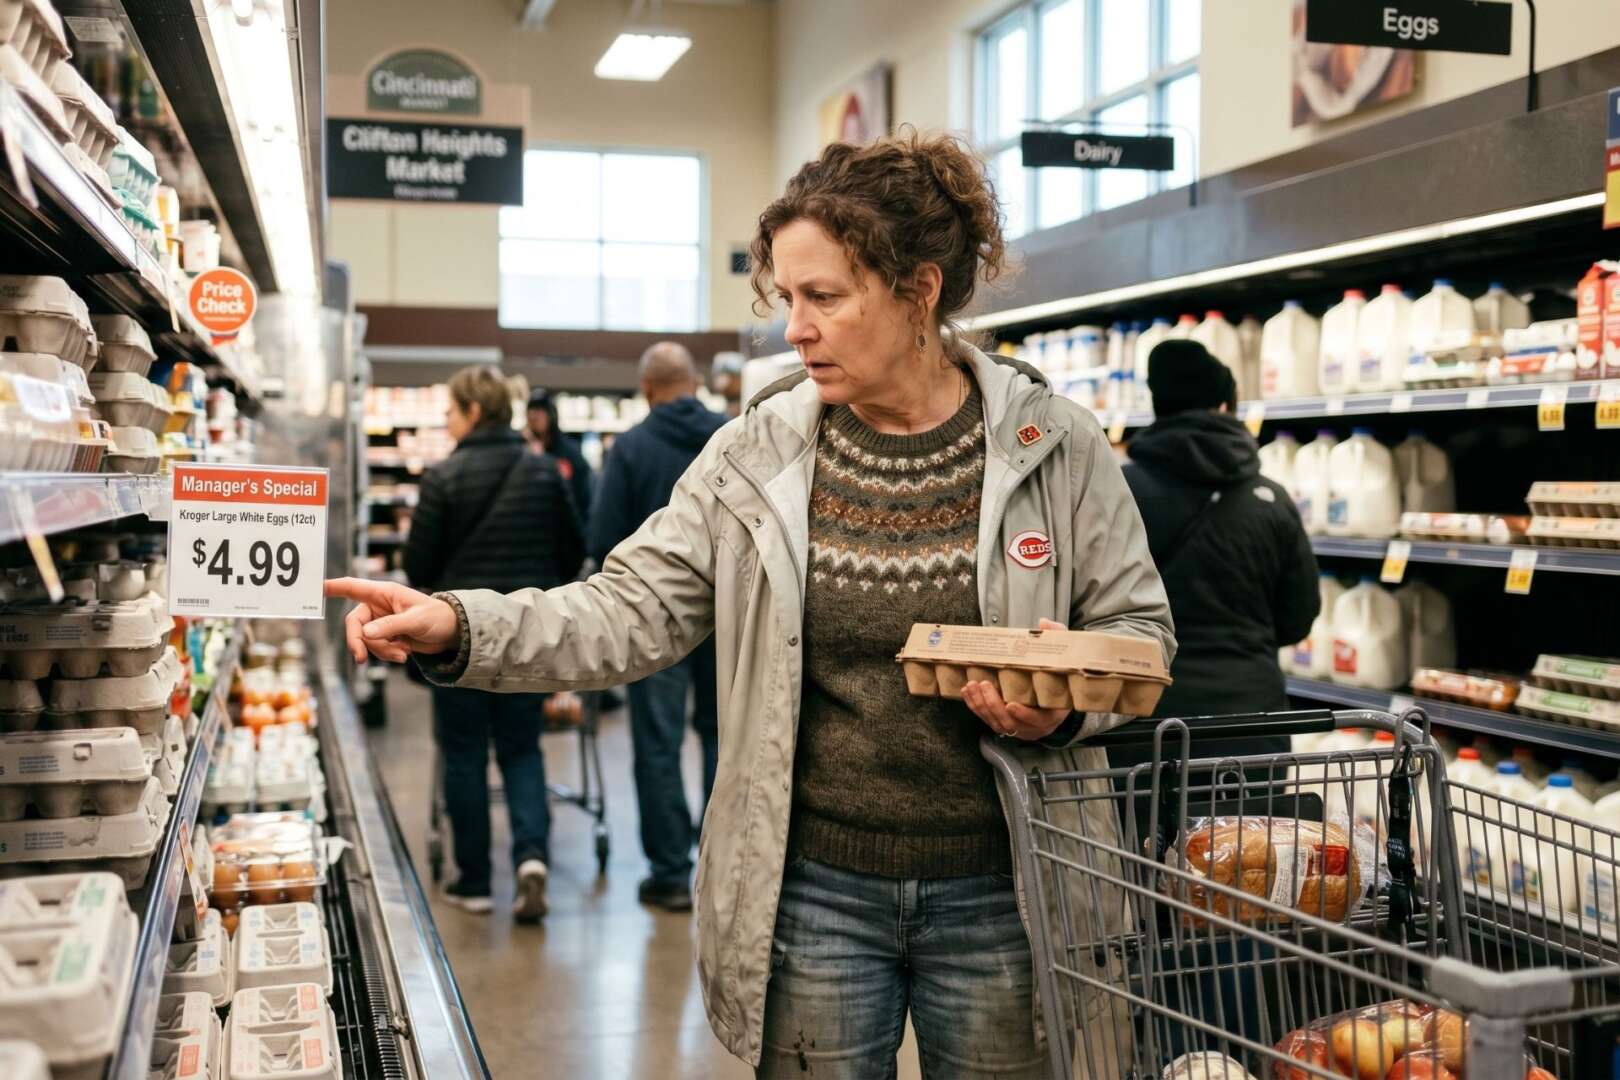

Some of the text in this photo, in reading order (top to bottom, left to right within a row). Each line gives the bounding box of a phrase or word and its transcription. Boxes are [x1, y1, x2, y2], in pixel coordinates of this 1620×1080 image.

[1383, 7, 1439, 40] Eggs
[372, 70, 477, 99] Cincinnati
[343, 125, 508, 160] Clifton Heights
[1074, 139, 1123, 167] Dairy
[386, 155, 466, 184] Market
[202, 281, 242, 297] Price
[197, 297, 246, 314] Check
[182, 475, 317, 498] Manager's Special
[179, 509, 316, 526] Kroger Large White Eggs (12ct)
[192, 537, 301, 588] $4.99
[1020, 543, 1052, 556] REDS
